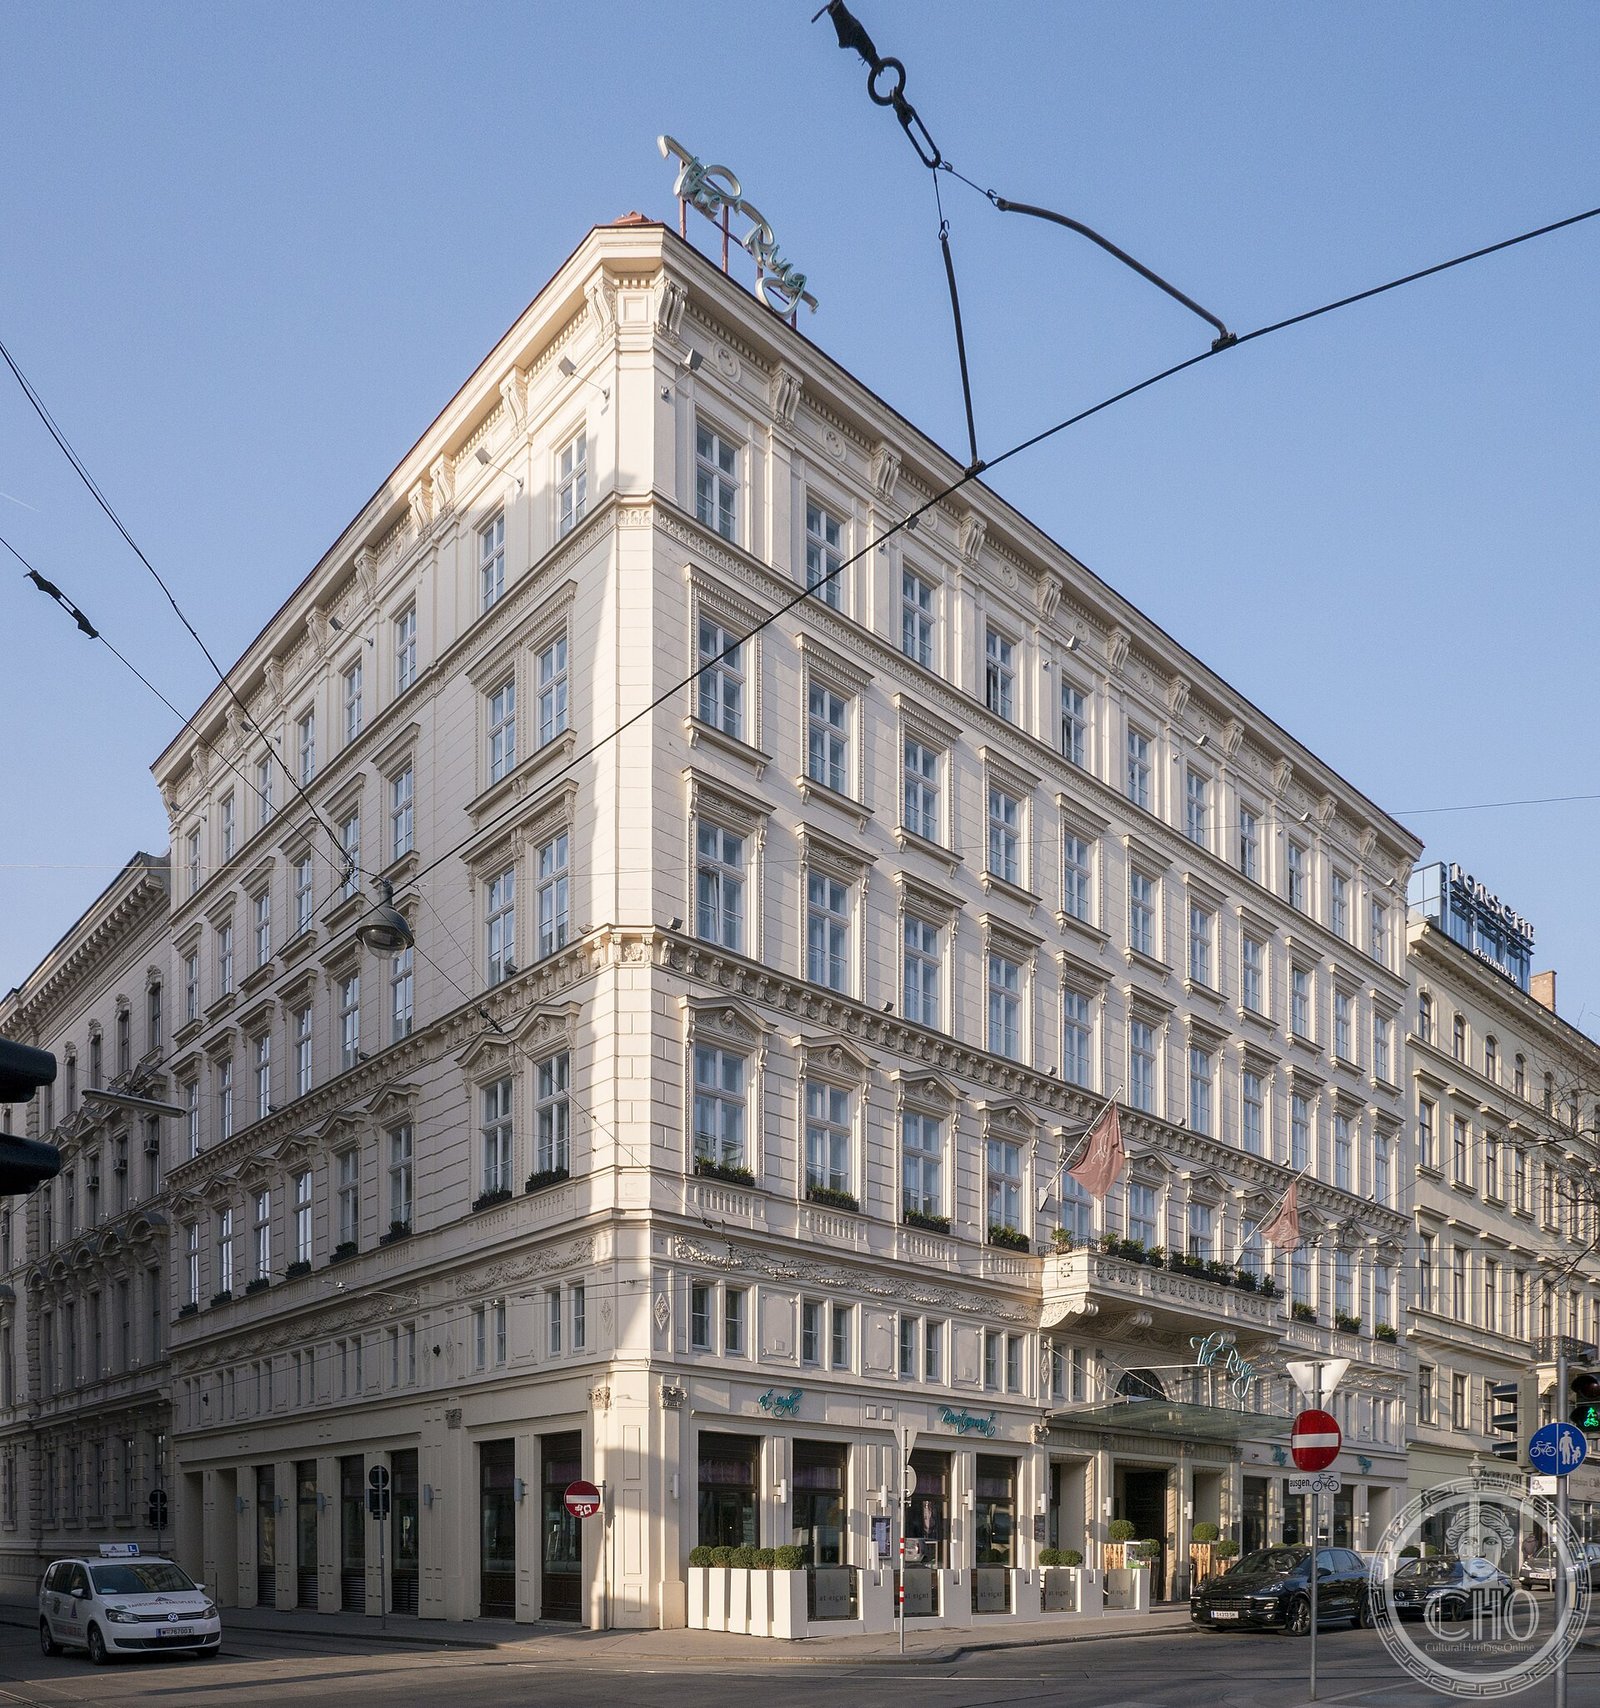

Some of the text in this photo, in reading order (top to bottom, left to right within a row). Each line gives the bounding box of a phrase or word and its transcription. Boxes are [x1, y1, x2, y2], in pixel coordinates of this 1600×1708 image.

[1449, 862, 1536, 940] PORSCHE
[1189, 1331, 1258, 1401] The Ring
[1289, 1479, 1312, 1489] ausgen.
